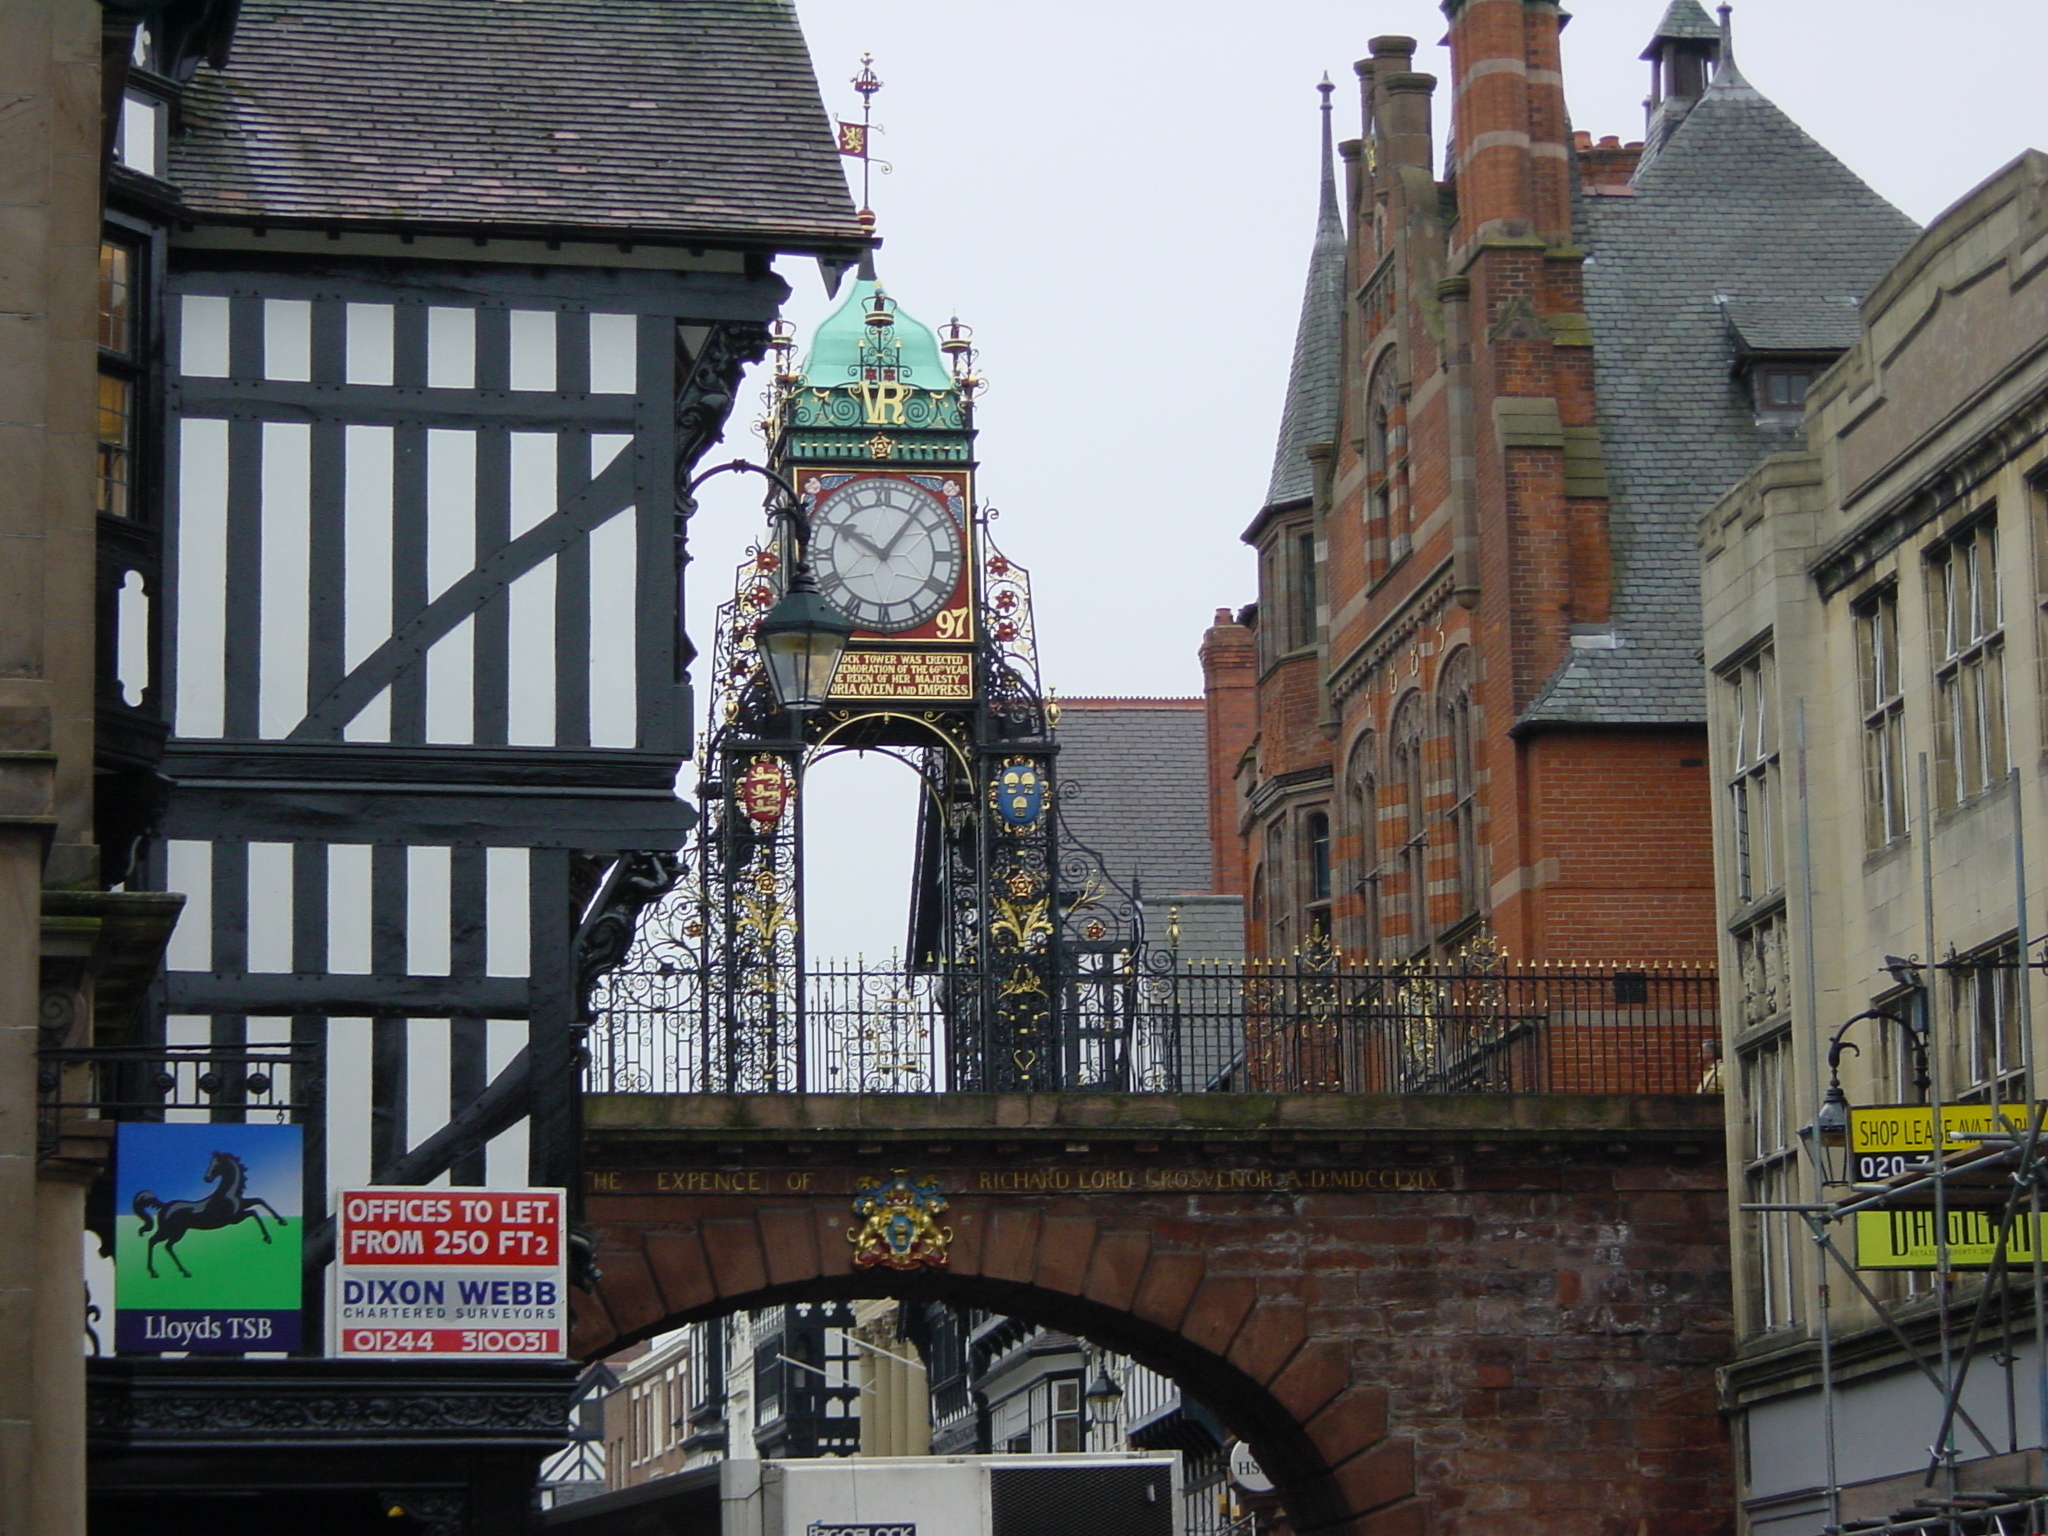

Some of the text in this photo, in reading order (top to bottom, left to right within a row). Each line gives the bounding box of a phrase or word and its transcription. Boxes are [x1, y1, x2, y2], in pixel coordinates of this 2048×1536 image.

[936, 607, 969, 639] 97
[864, 655, 897, 664] TOWER
[901, 655, 922, 664] WAS
[926, 656, 963, 665] ERECTED
[897, 665, 908, 674] OF
[910, 665, 928, 674] THE
[945, 665, 969, 675] YEAR
[846, 674, 873, 684] REIGN
[877, 674, 889, 683] OF
[892, 674, 911, 684] HER
[915, 674, 960, 684] MAJESTY
[896, 686, 917, 695] AND
[918, 684, 969, 696] EMPRESS
[1860, 1119, 1899, 1146] SHOP
[1860, 1155, 1905, 1178] 020
[657, 1171, 761, 1190] EXPENCE
[787, 1172, 814, 1190] OF
[979, 1171, 1069, 1190] RICHARD
[1078, 1170, 1133, 1189] LORD
[347, 1198, 554, 1224] OFFICES TO LET.
[350, 1229, 424, 1255] FROM
[434, 1229, 489, 1256] 250
[343, 1280, 557, 1306] DIXON WEBB
[343, 1307, 556, 1319] CHARTERED SURVEYORS
[144, 1315, 273, 1346] Lloyds TSB
[353, 1330, 548, 1351] 01244 310031
[1238, 1461, 1261, 1475] HS
